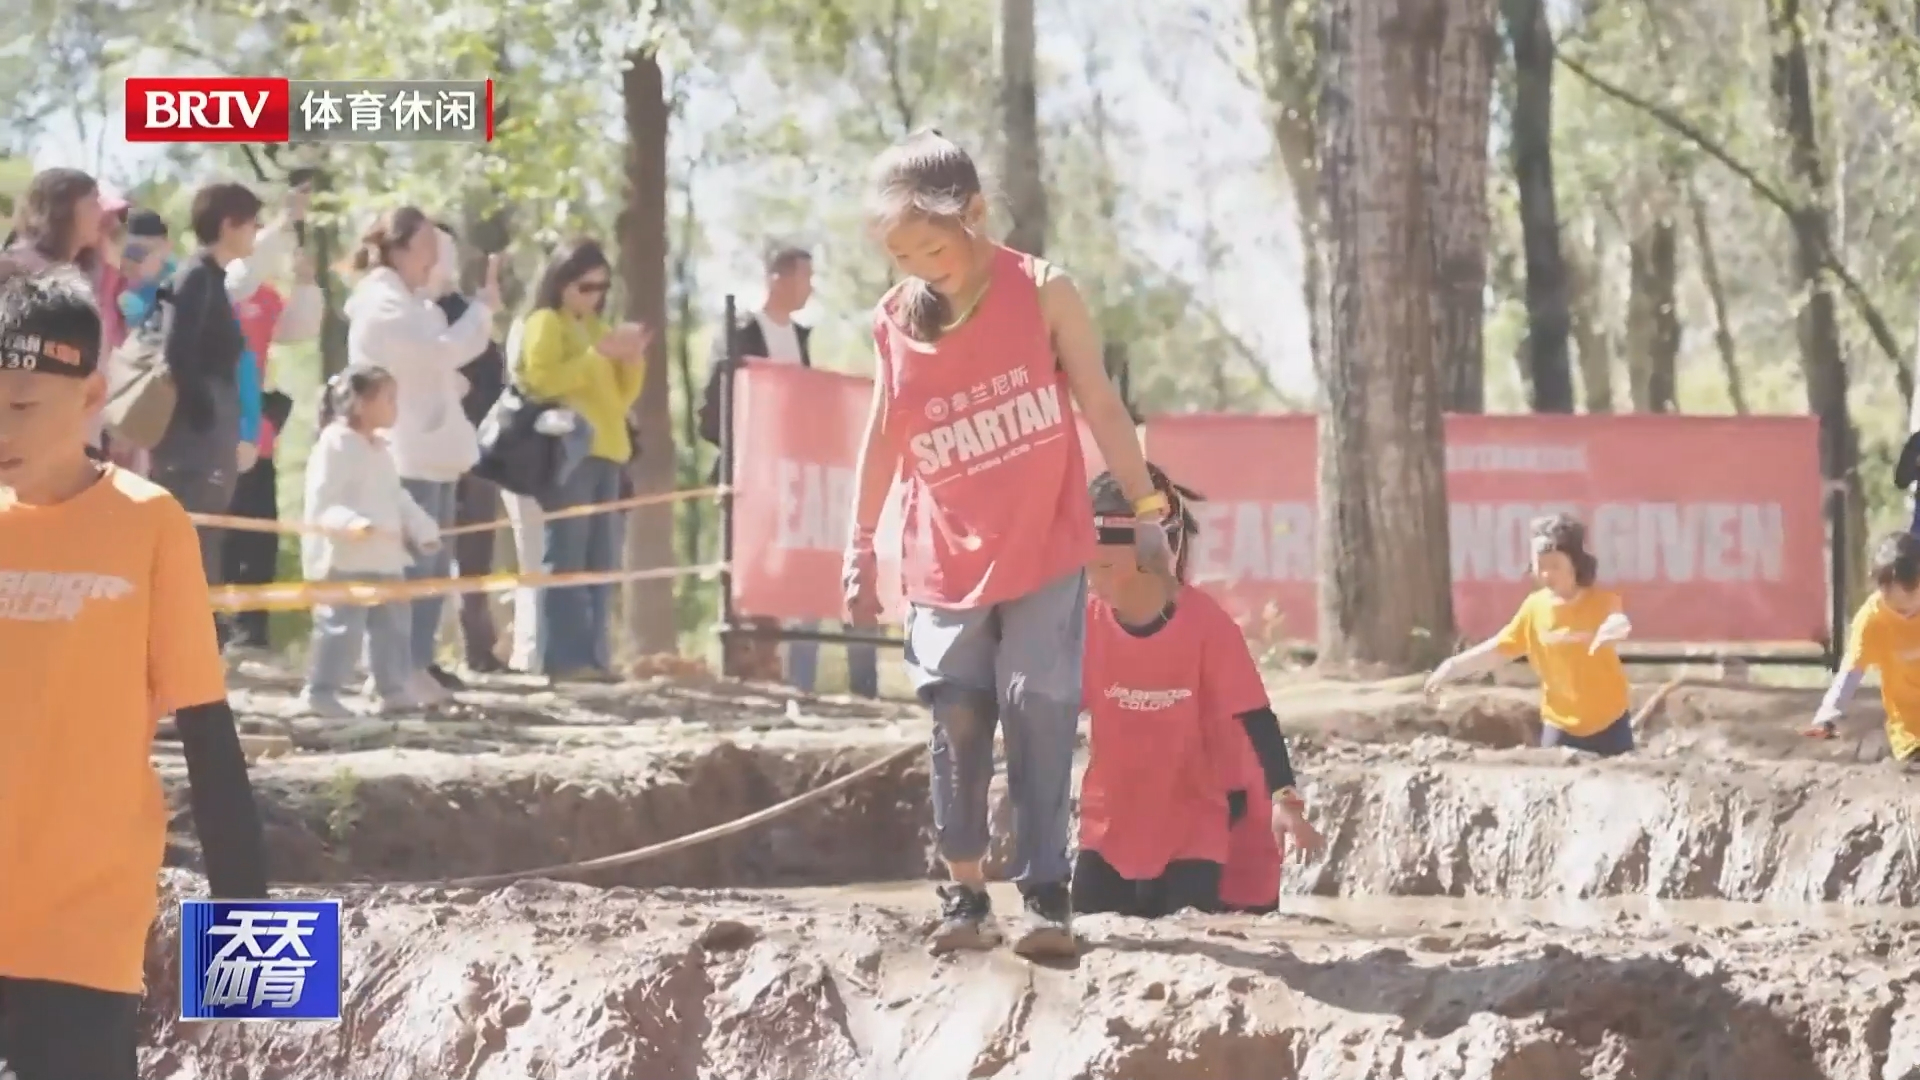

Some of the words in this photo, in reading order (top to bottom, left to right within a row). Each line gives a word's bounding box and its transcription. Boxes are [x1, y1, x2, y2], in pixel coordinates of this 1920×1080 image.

[910, 384, 1062, 475] SPARTAN
[1190, 500, 1318, 582] EAR
[1450, 500, 1582, 582] NO
[1593, 500, 1784, 583] GIVEN
